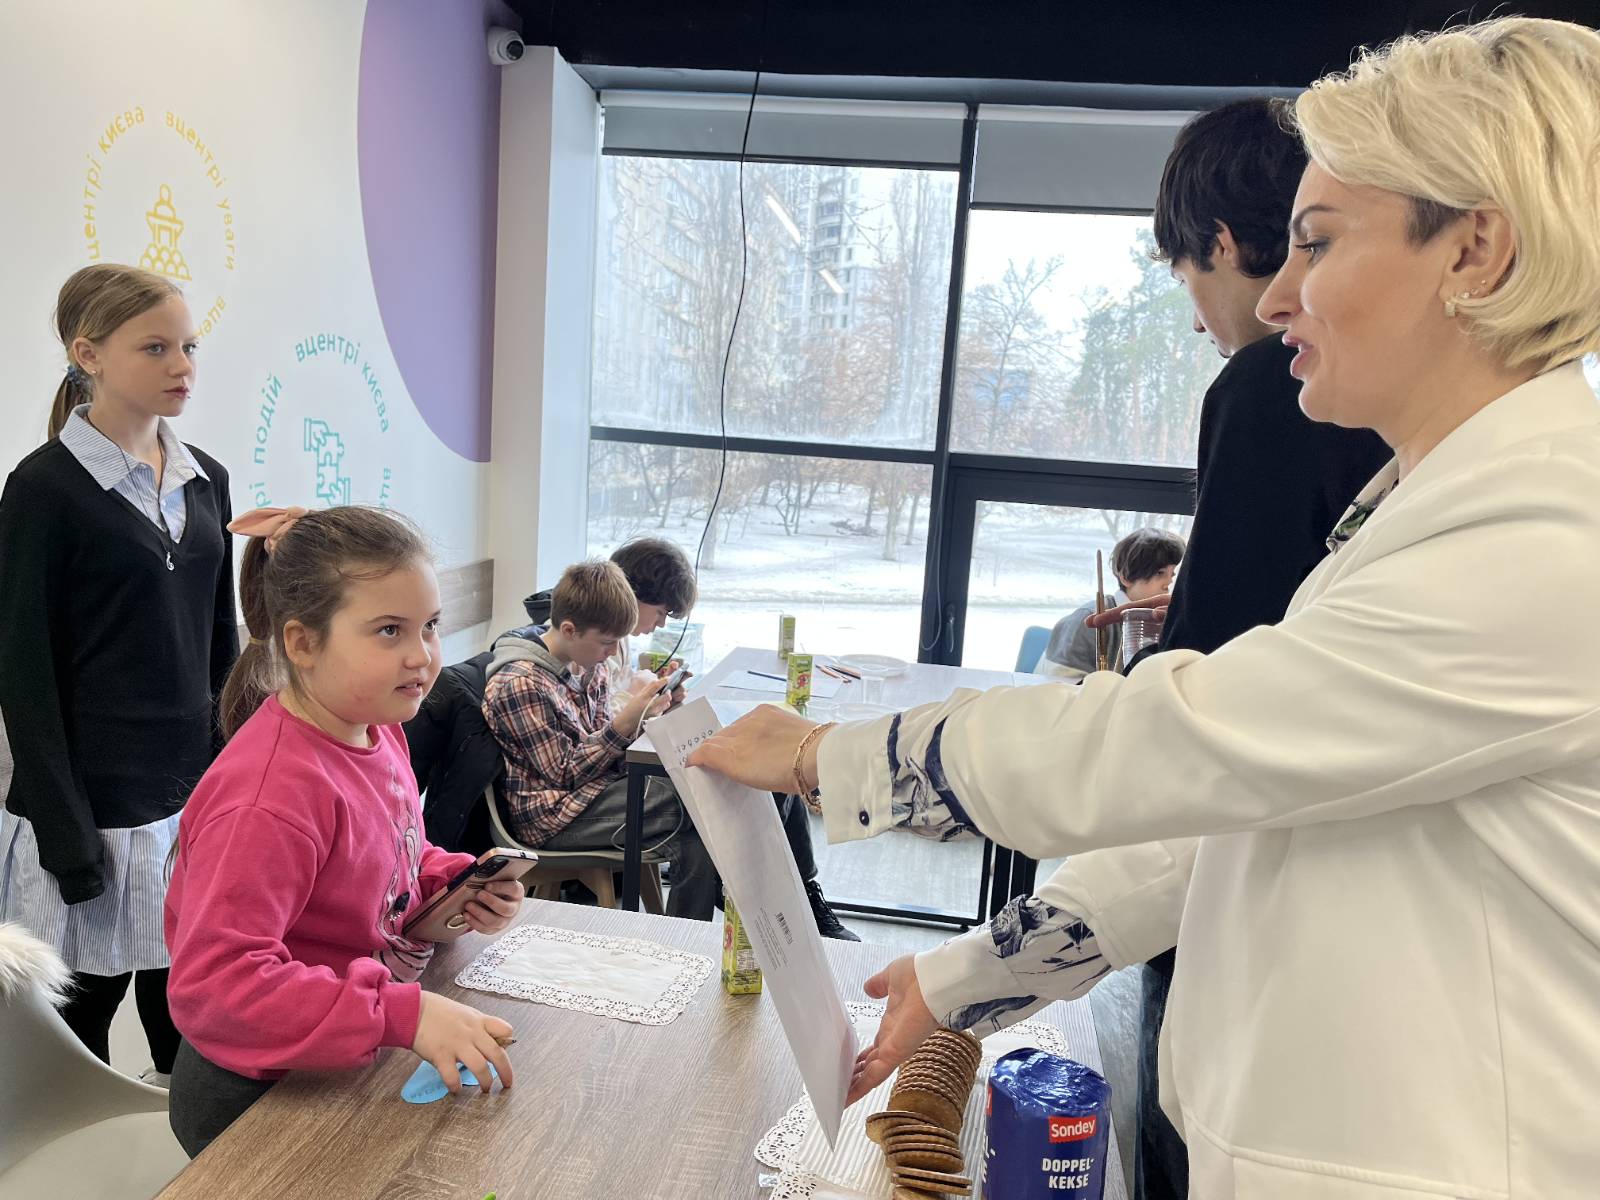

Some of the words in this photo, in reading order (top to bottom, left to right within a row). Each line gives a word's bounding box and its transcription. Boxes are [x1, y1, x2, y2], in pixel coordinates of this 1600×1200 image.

[83, 153, 102, 260] центрі
[165, 111, 227, 188] вцентрі
[217, 198, 235, 271] уваги
[295, 333, 361, 365] вцентрі
[254, 371, 283, 464] подій
[1051, 1119, 1096, 1138] Sondey
[1048, 1173, 1089, 1190] KEKSE
